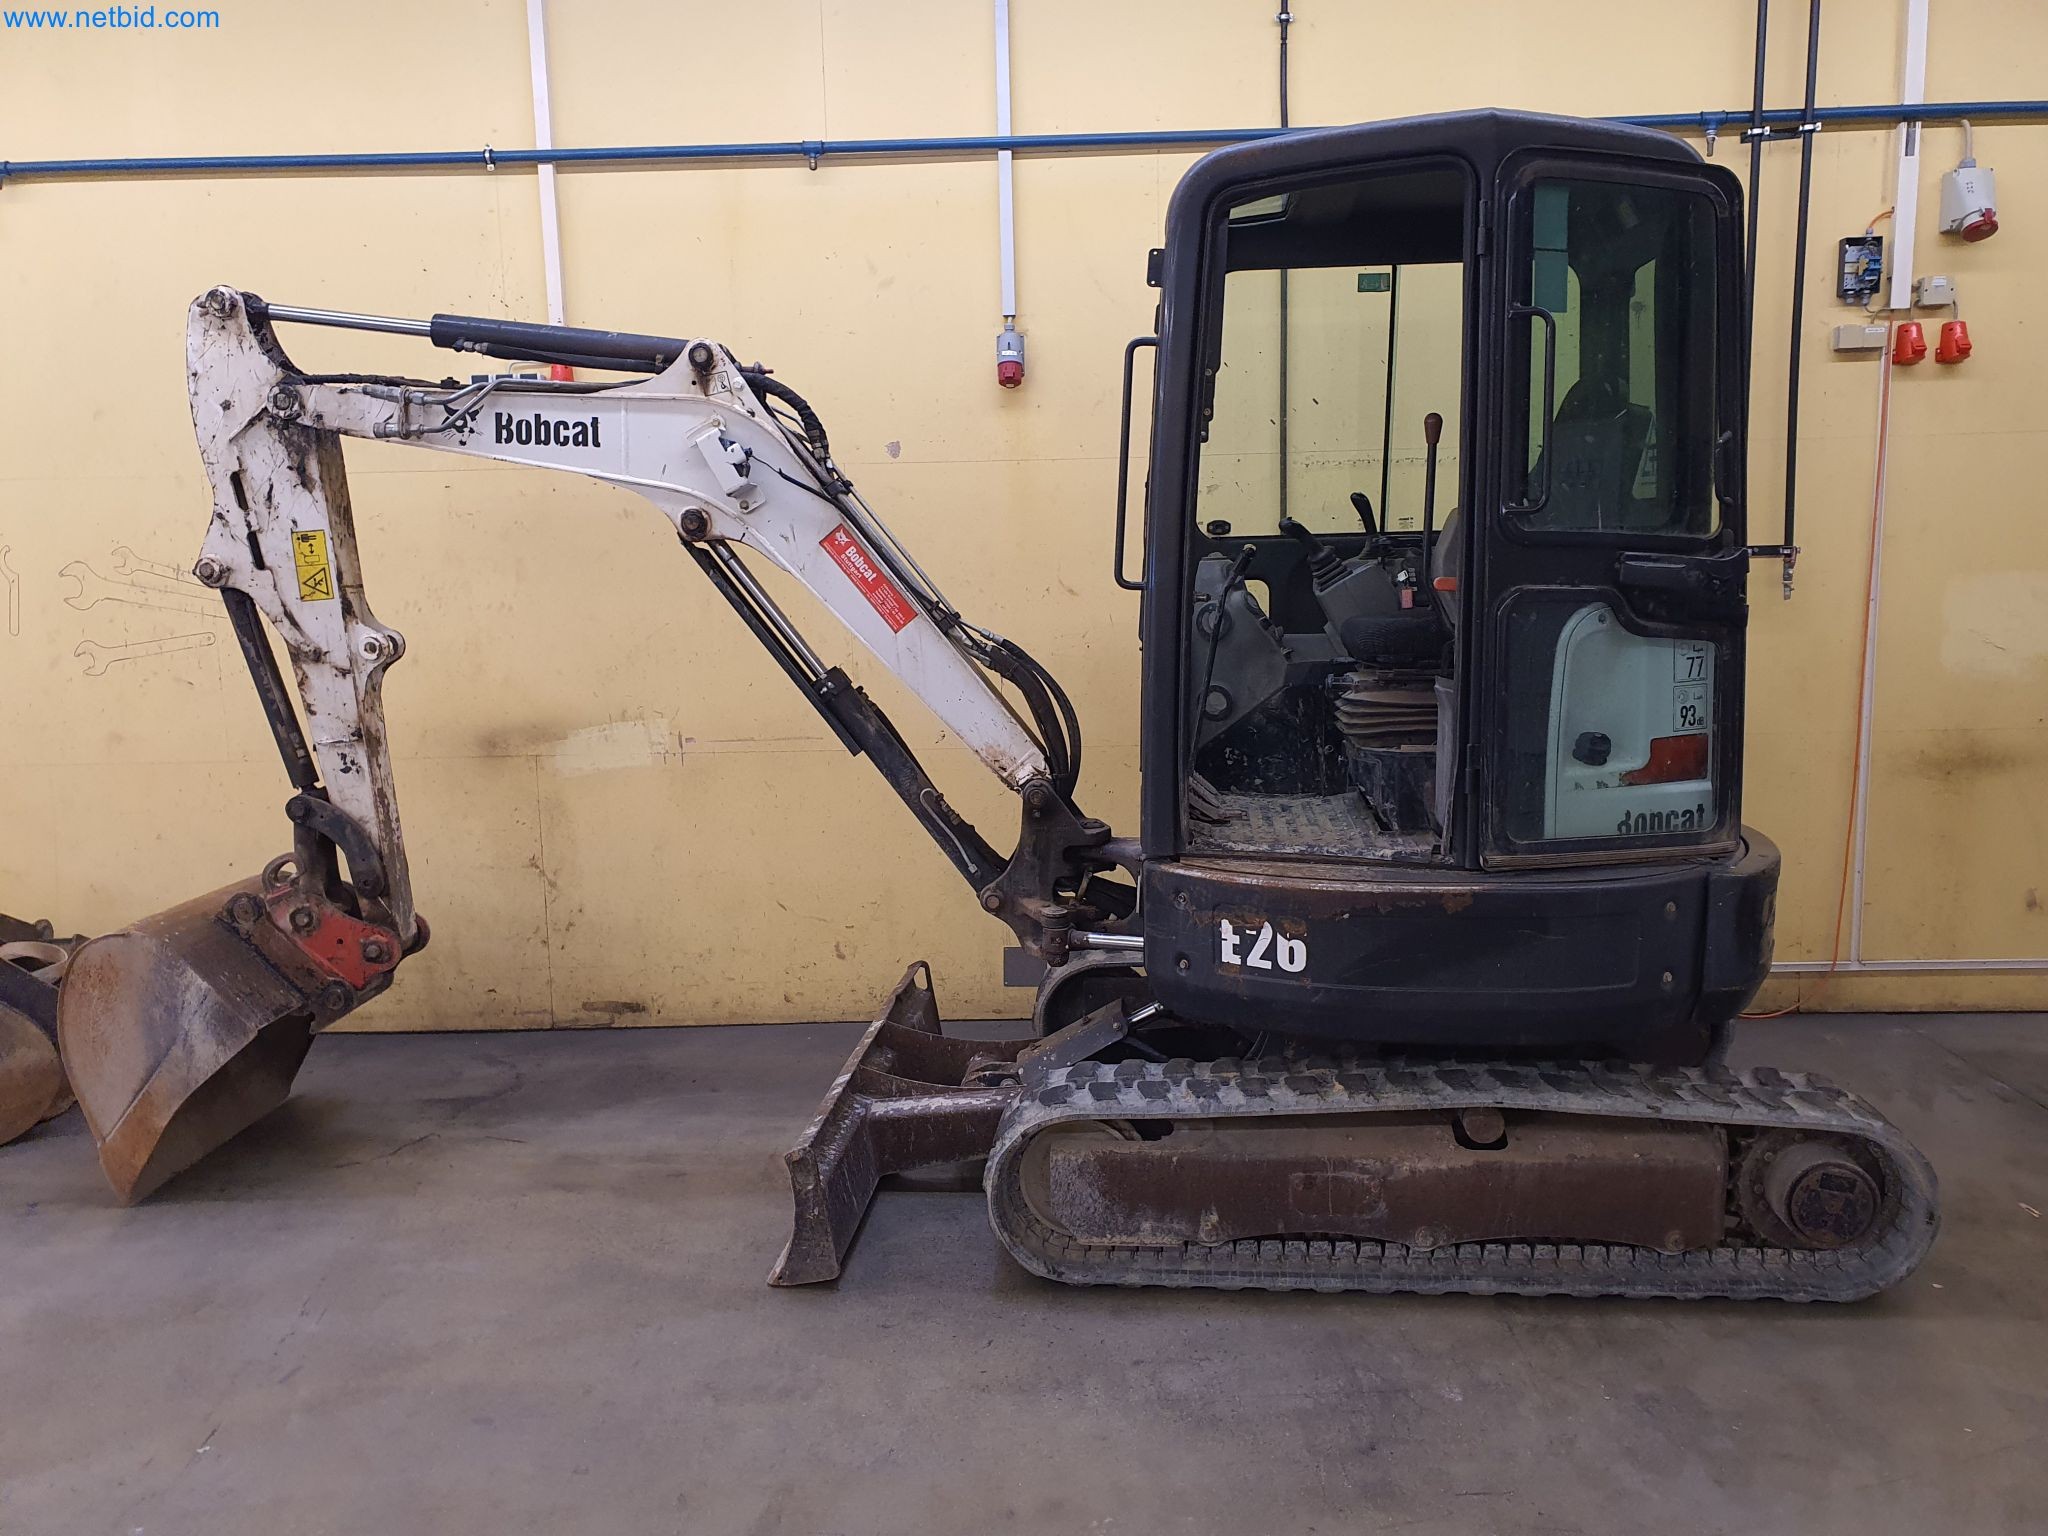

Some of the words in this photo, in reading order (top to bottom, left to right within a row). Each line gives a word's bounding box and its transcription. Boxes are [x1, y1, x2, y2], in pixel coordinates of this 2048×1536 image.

[495, 412, 601, 448] Bobcat
[840, 553, 862, 579] Stuttgart
[844, 545, 877, 583] Bobcat
[1686, 656, 1705, 678] 77
[1220, 919, 1307, 972] E26
